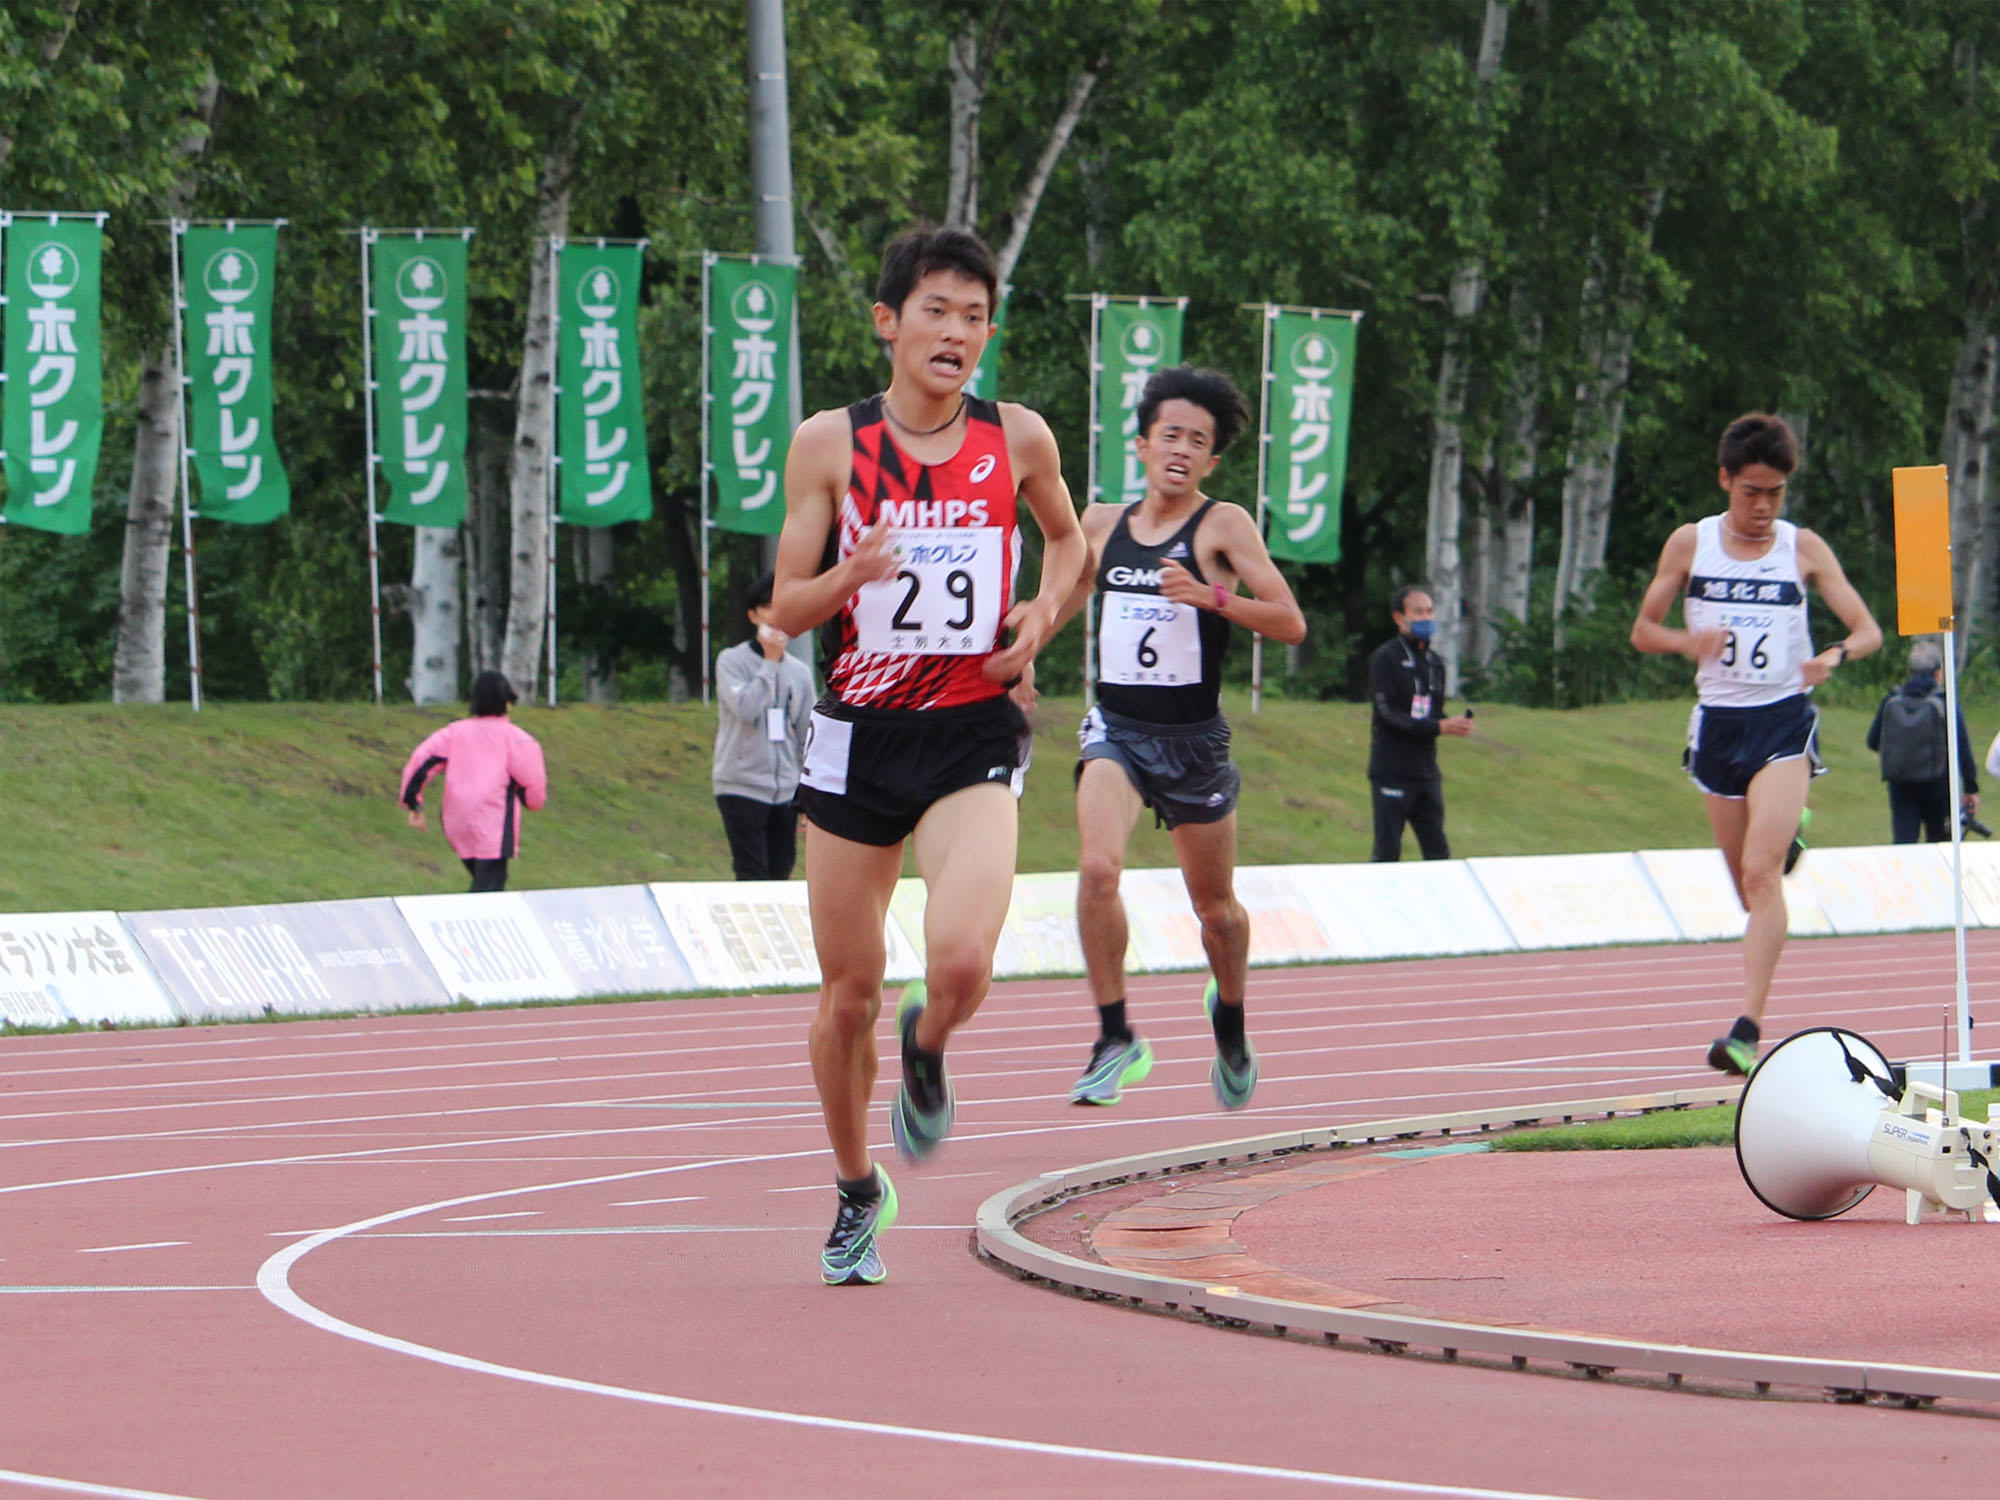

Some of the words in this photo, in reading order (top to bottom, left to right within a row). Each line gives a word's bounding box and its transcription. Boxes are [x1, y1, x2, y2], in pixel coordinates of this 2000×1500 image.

[27, 300, 79, 507] ホクレン
[205, 305, 263, 500] ホクレン
[398, 312, 449, 505] ホクレン
[579, 320, 631, 507] ホクレン
[731, 333, 779, 511] ホクレン
[1286, 380, 1335, 542] ホクレン
[879, 499, 991, 528] MHPS
[909, 544, 979, 566] ホクレン
[892, 570, 974, 631] 29
[1702, 580, 1782, 602] 旭化成
[1137, 625, 1158, 669] 6
[430, 916, 548, 985] SEKISUI
[553, 914, 667, 972] 積水化学
[1882, 1122, 1908, 1139] SUPER
